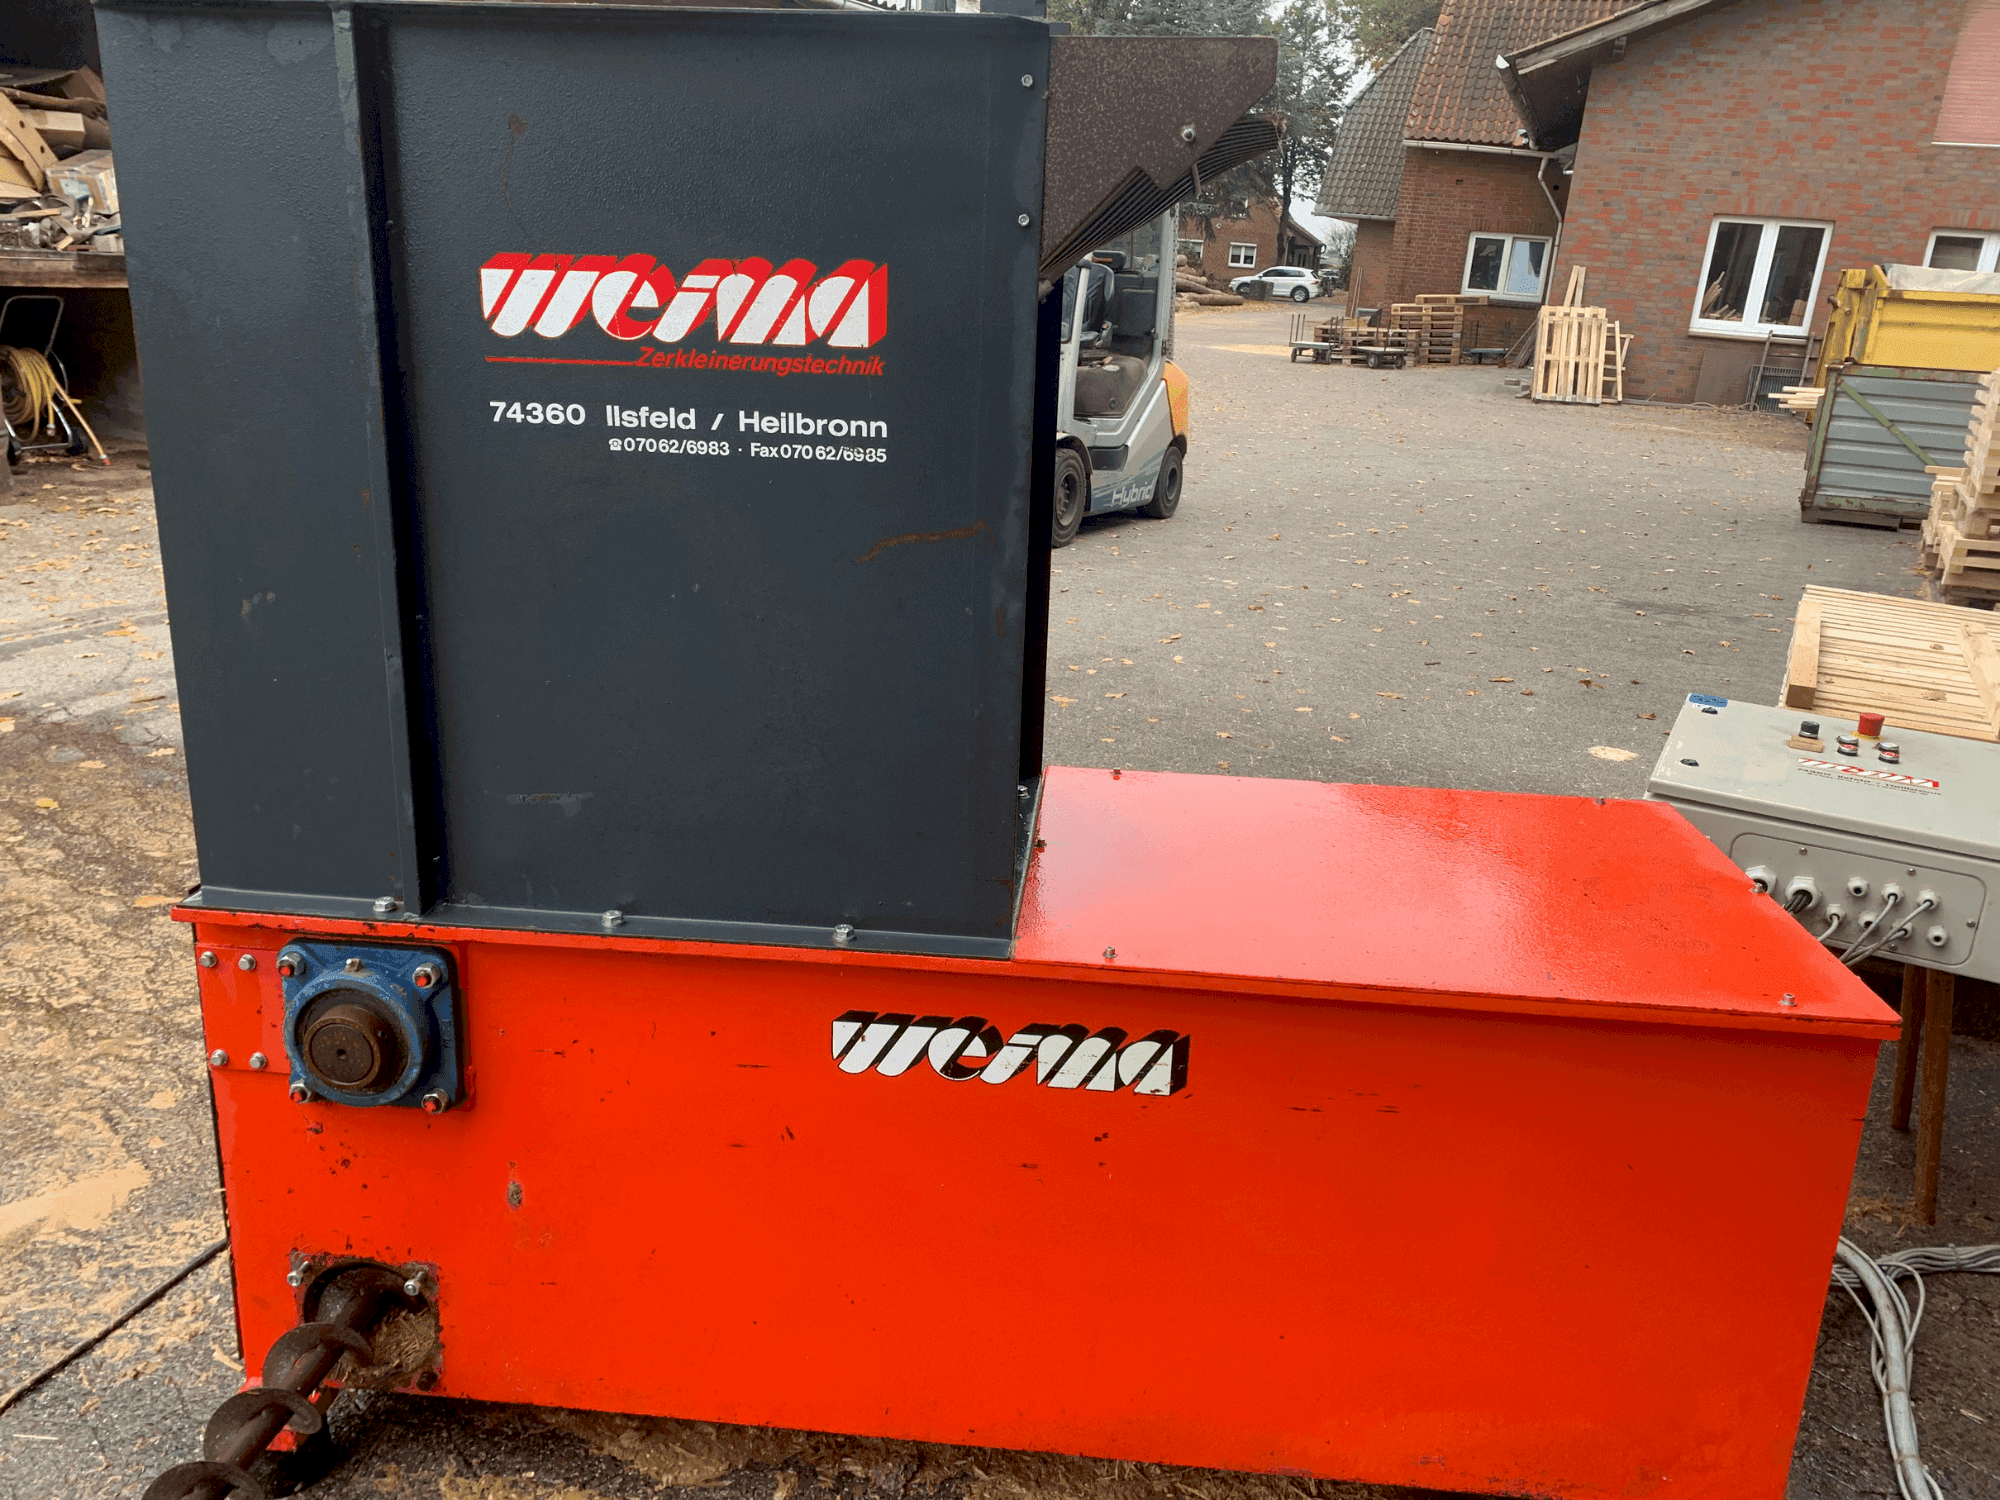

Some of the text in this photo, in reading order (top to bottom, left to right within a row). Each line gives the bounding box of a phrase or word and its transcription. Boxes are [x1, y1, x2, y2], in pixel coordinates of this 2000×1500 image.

[634, 347, 887, 377] Zerkleinerungstechnik
[489, 400, 888, 438] 74360 Ilsfeld / Heilbronn
[1111, 480, 1155, 508] Hybrid
